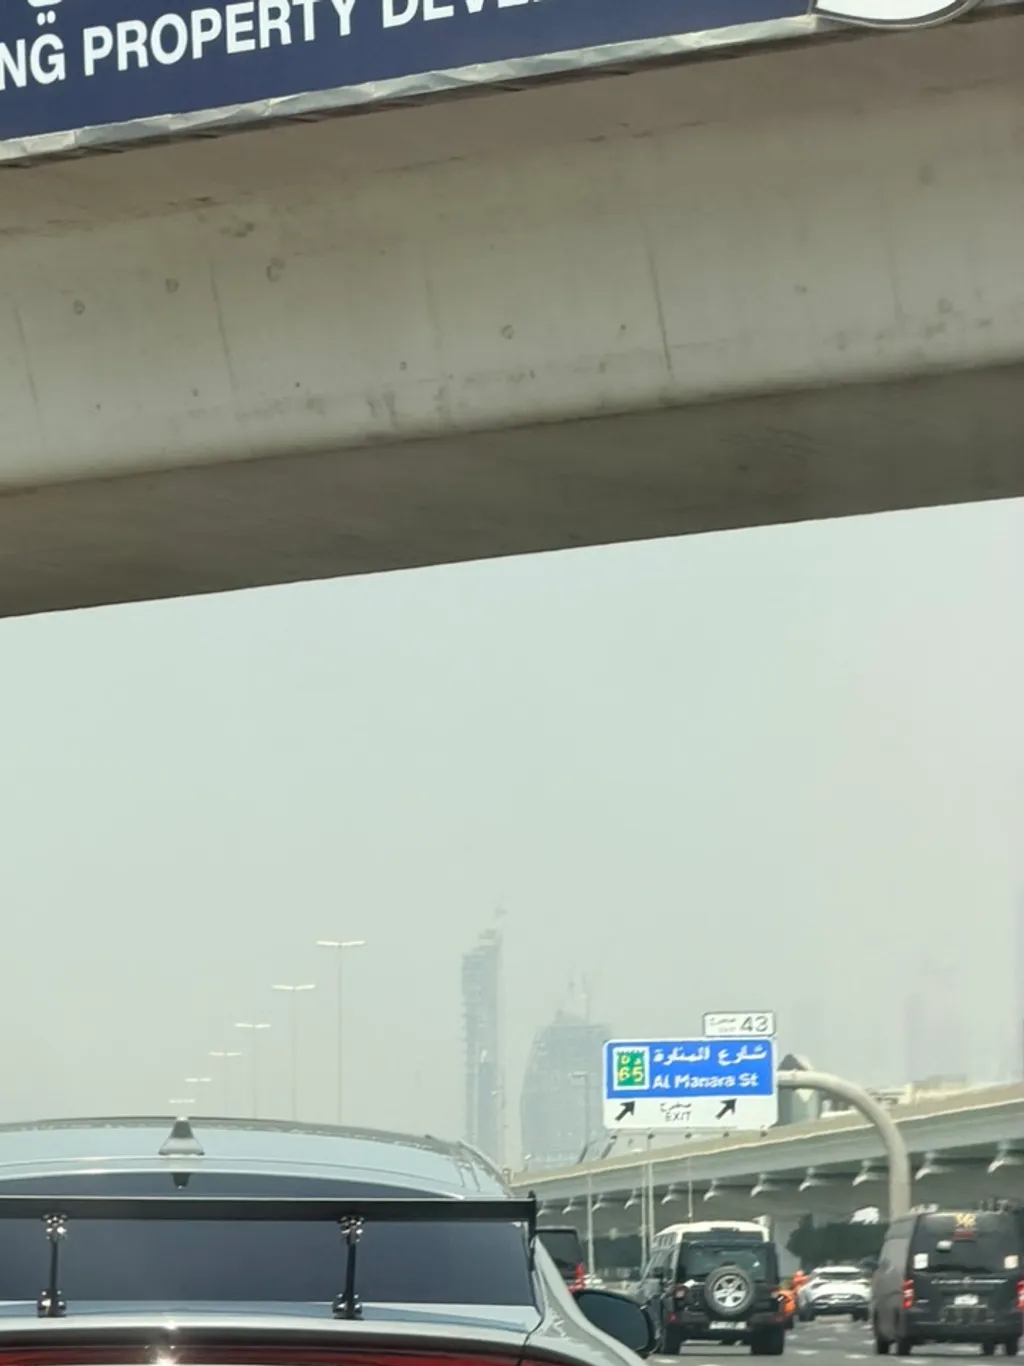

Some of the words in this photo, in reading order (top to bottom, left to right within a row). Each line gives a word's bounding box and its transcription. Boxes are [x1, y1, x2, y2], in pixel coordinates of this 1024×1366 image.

[83, 0, 358, 77] PROPERTY
[739, 1015, 769, 1033] 43
[718, 1044, 769, 1067] شارع
[652, 1074, 671, 1089] Al
[674, 1073, 736, 1089] Manara
[738, 1072, 760, 1088] St
[665, 1110, 692, 1123] EXIT
